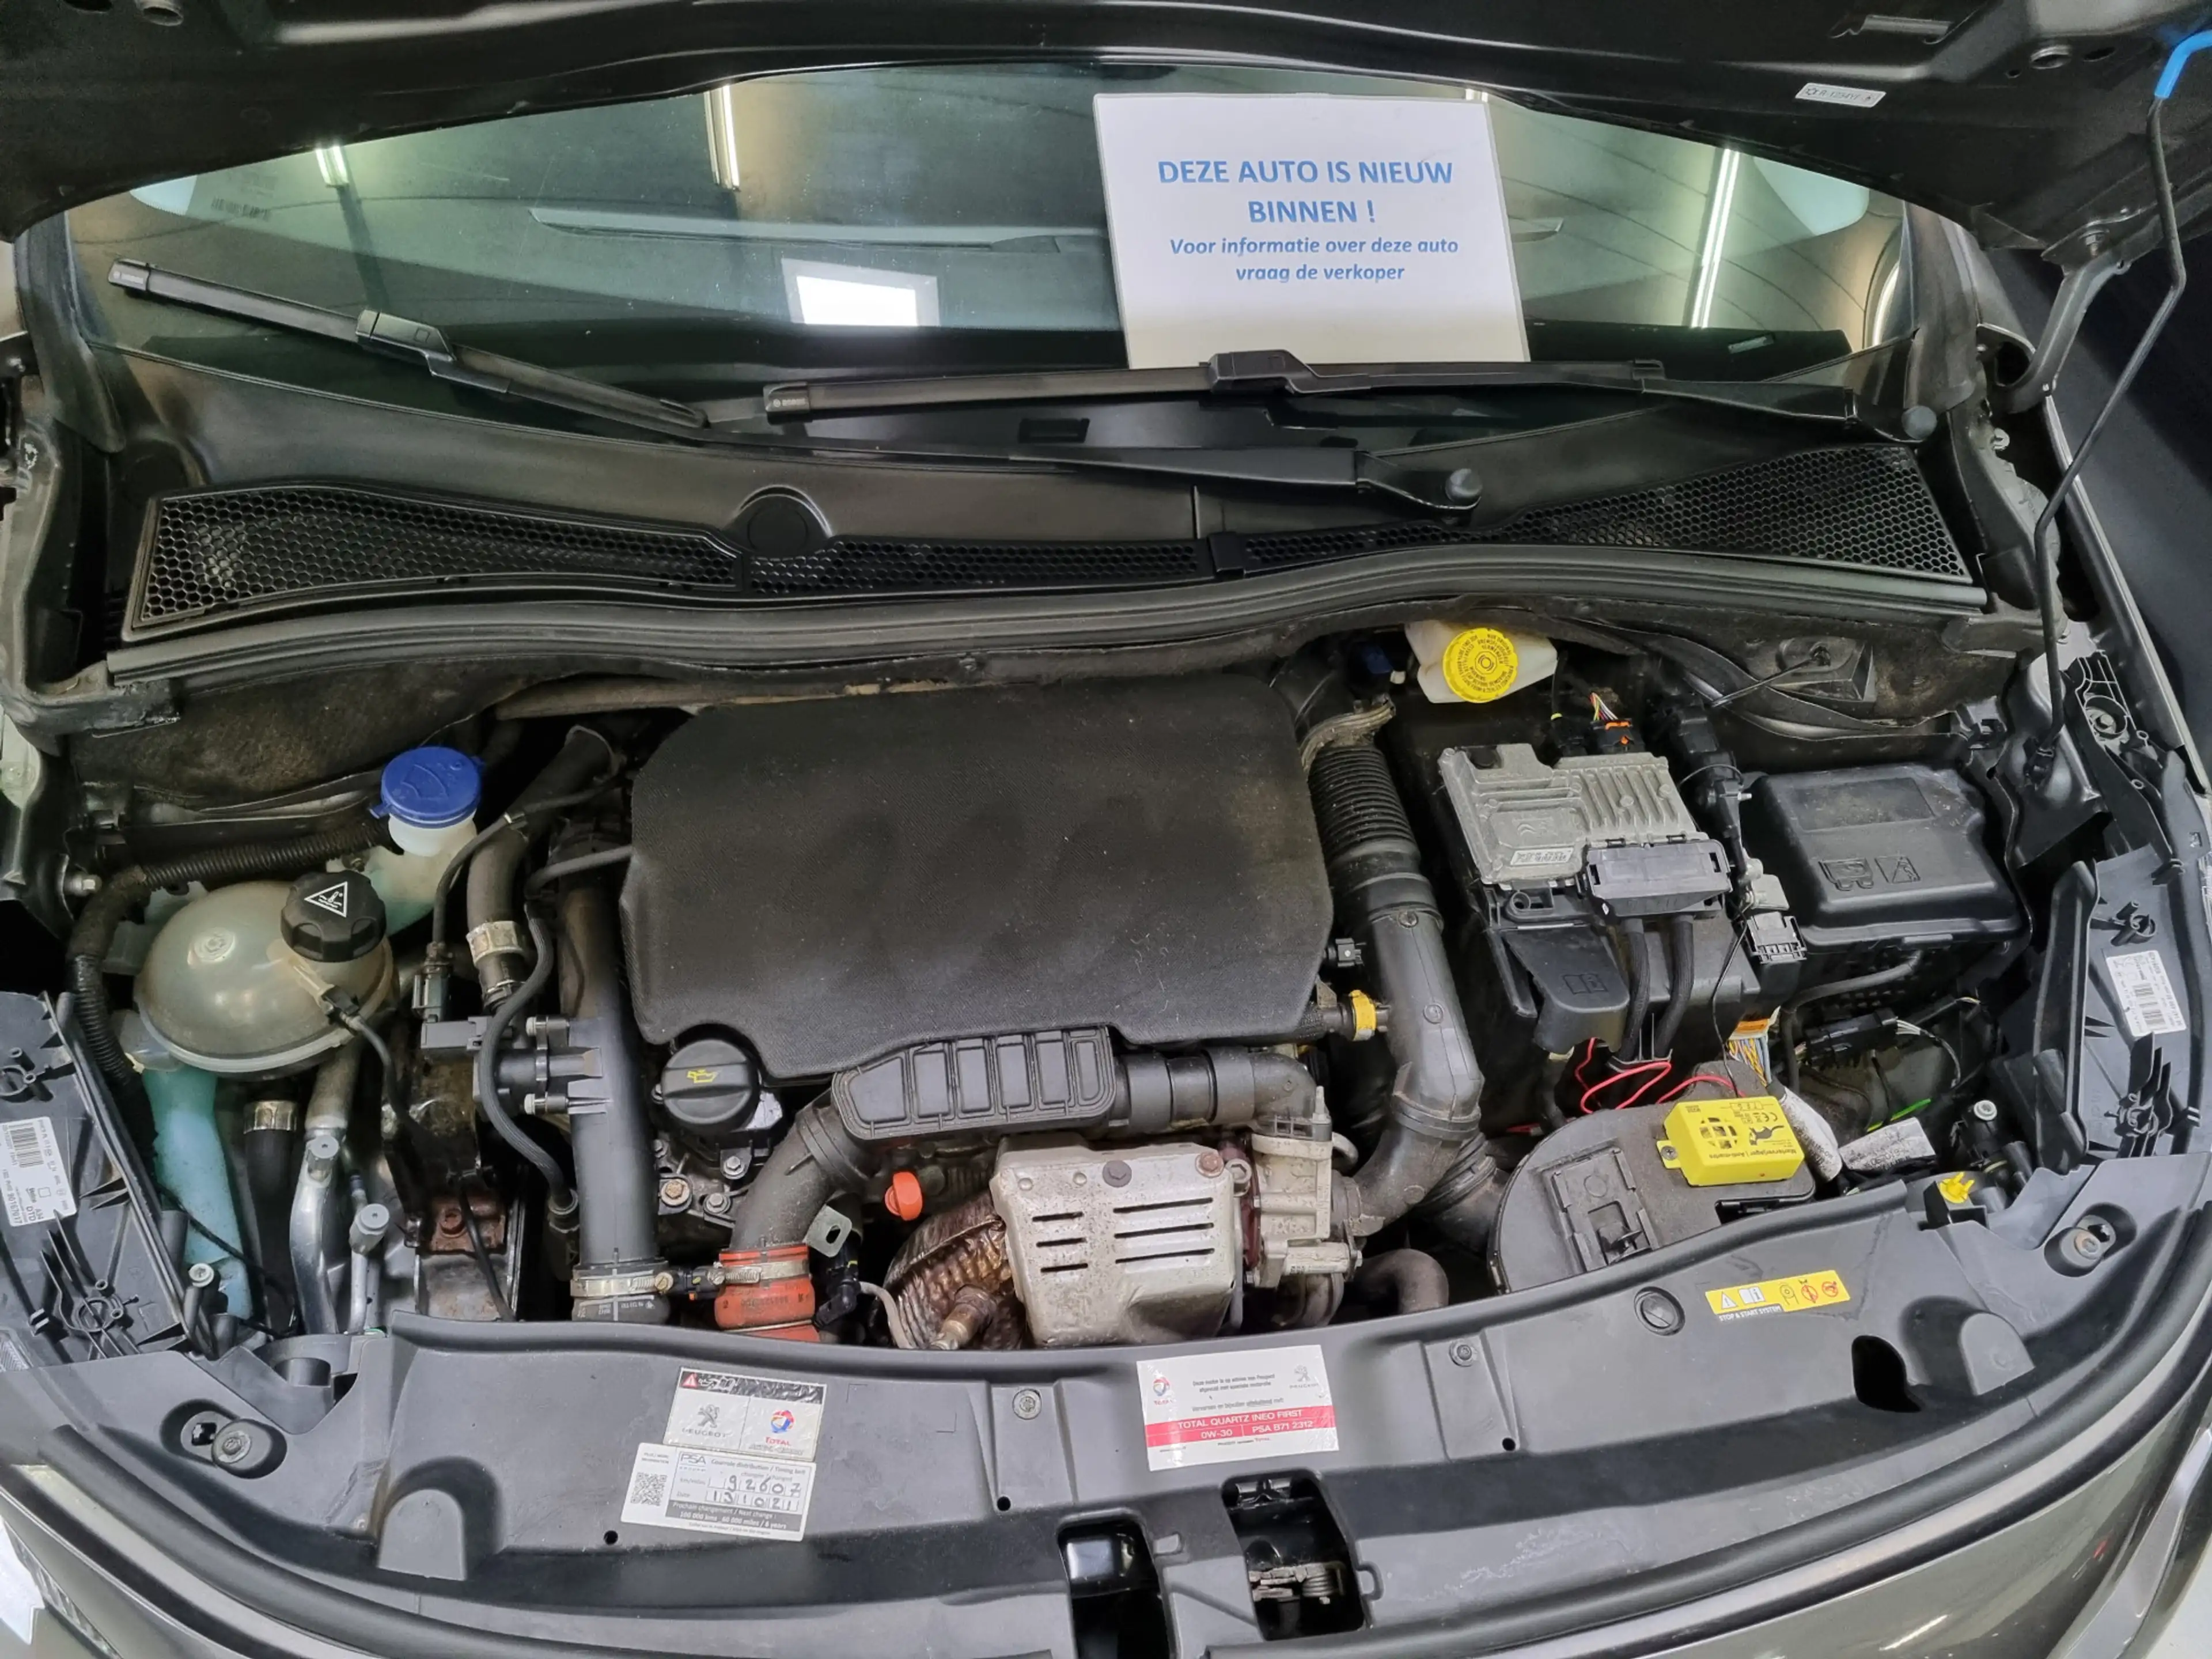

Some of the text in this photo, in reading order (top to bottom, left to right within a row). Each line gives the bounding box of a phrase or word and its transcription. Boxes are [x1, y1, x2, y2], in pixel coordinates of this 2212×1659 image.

[1158, 161, 1453, 183] DEZE AUTO IS NIEUW
[1248, 200, 1376, 223] BINNEN !
[1170, 237, 1459, 256] Voor informatie over deze auto
[1236, 264, 1405, 283] vraag de verkoper
[1719, 1313, 1734, 1322] STOP
[1741, 1309, 1758, 1319] START
[1759, 1305, 1782, 1316] SYSTEM
[1178, 1410, 1303, 1430] TOTAL QUARTZ INEO FIRST
[1200, 1421, 1313, 1440] 0W-30 PSA B71 2312
[766, 1437, 791, 1446] TOTAL
[680, 1453, 706, 1464] PSA
[698, 1504, 733, 1515] changement
